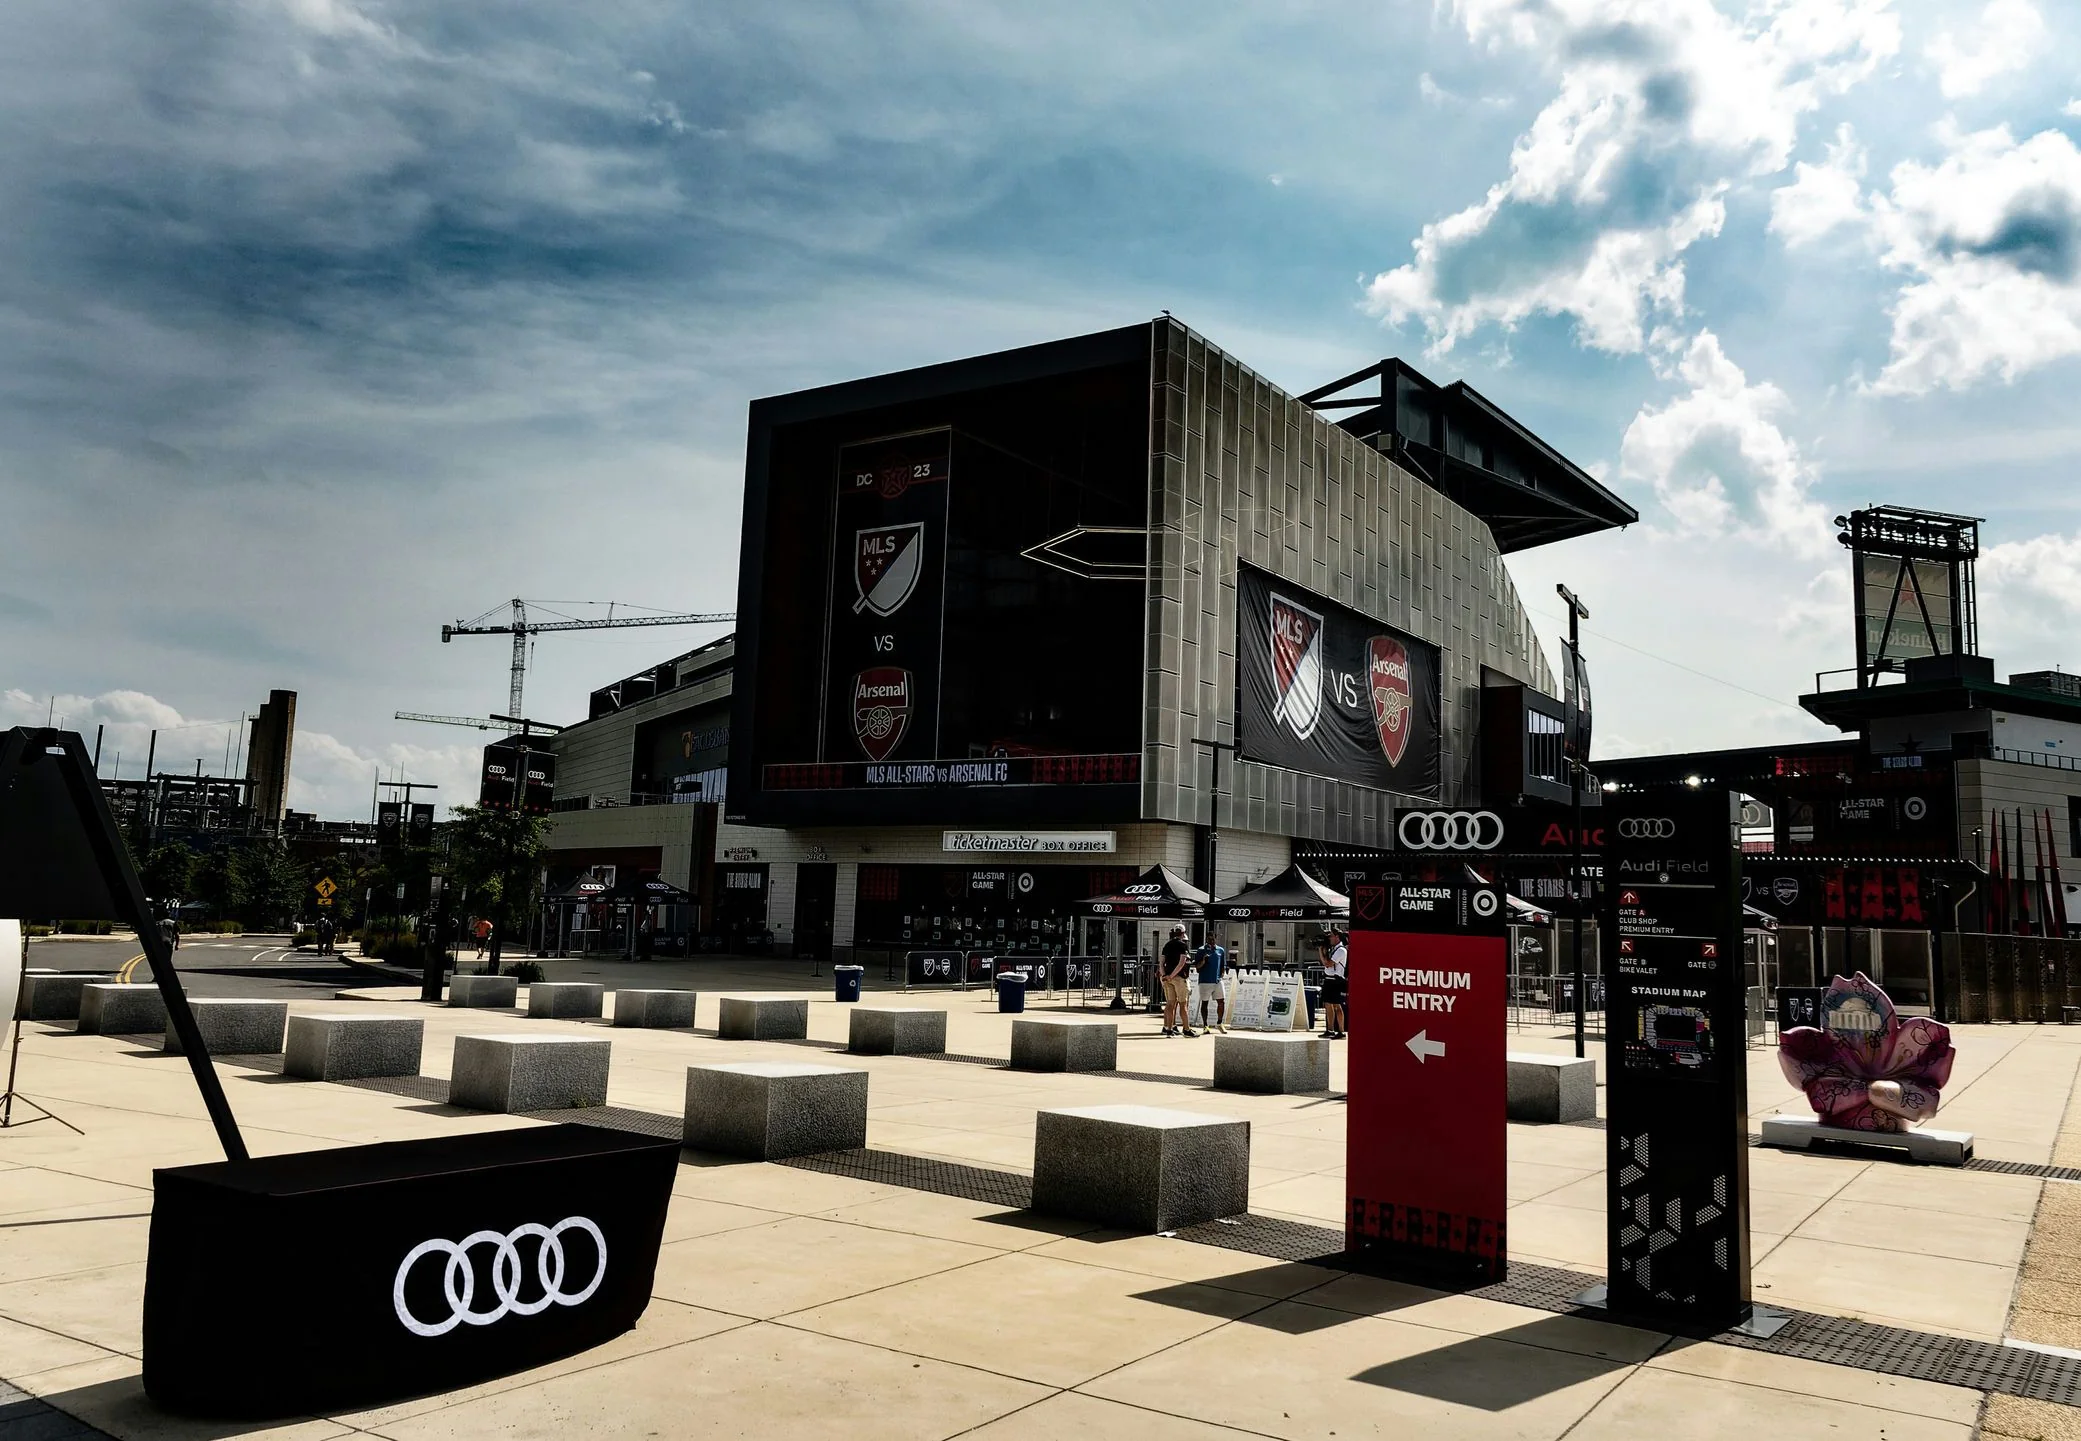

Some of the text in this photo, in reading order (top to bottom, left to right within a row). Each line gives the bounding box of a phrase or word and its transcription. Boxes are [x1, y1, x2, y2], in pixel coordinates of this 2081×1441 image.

[856, 463, 931, 487] DC 23
[863, 535, 896, 556] MLS
[1276, 610, 1304, 644] MLS
[874, 635, 894, 652] VS
[1371, 654, 1409, 681] Arsenal
[858, 681, 904, 699] Arsenal
[1330, 668, 1358, 708] VS
[501, 775, 515, 783] Field
[866, 765, 885, 784] MLS
[886, 764, 935, 783] ALL-STARS
[949, 763, 993, 783] ARSENAL
[995, 762, 1008, 781] FC
[951, 834, 1107, 851] ticketmaster BOX OFFICE
[806, 853, 828, 861] OFFICE
[1619, 859, 1709, 872] Audi Field
[972, 872, 1005, 881] ALL-STAR
[972, 881, 994, 889] GAME
[1400, 887, 1451, 899] ALL-STAR
[1519, 879, 1535, 897] THE
[1537, 879, 1565, 898] STARS
[1280, 909, 1303, 917] Field
[1400, 900, 1433, 911] GAME
[1380, 967, 1471, 990] PREMIUM
[1631, 986, 1707, 998] STADIUM MAP
[1393, 991, 1457, 1013] ENTRY
